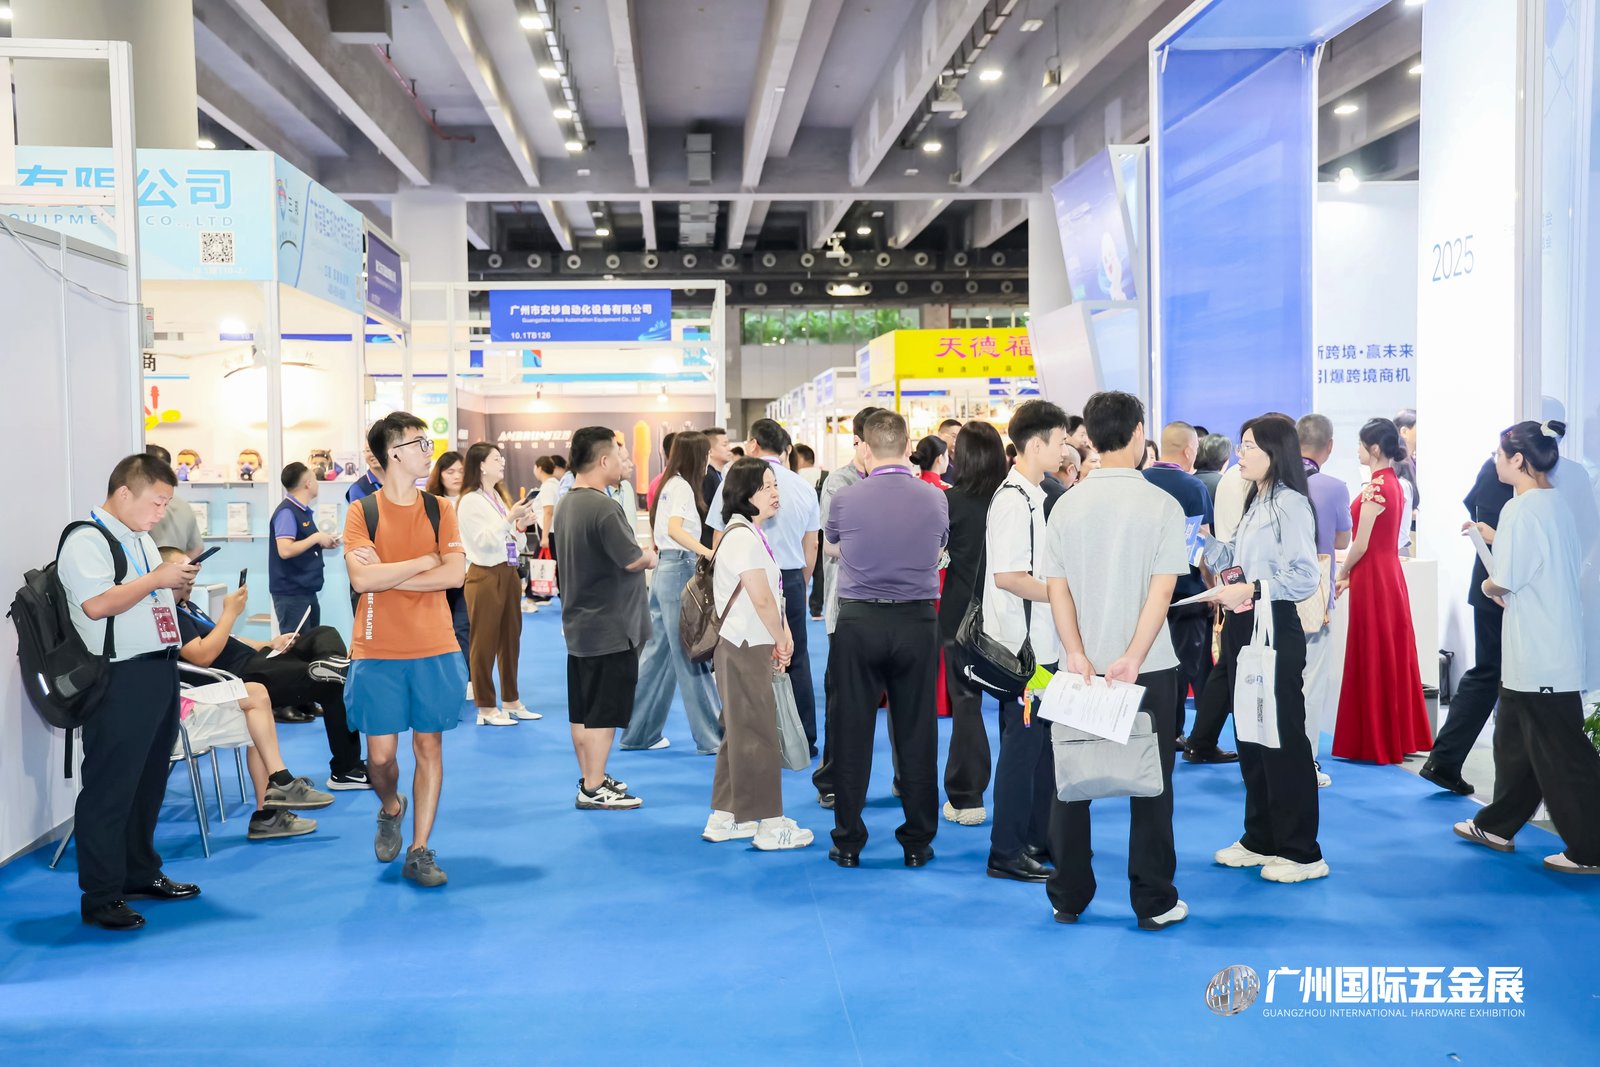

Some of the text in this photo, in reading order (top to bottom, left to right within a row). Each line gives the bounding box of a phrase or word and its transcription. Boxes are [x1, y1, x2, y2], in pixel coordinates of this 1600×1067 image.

[1432, 235, 1474, 282] 2025
[935, 336, 1033, 358] 天德福
[365, 592, 374, 640] REE-ISOLATION
